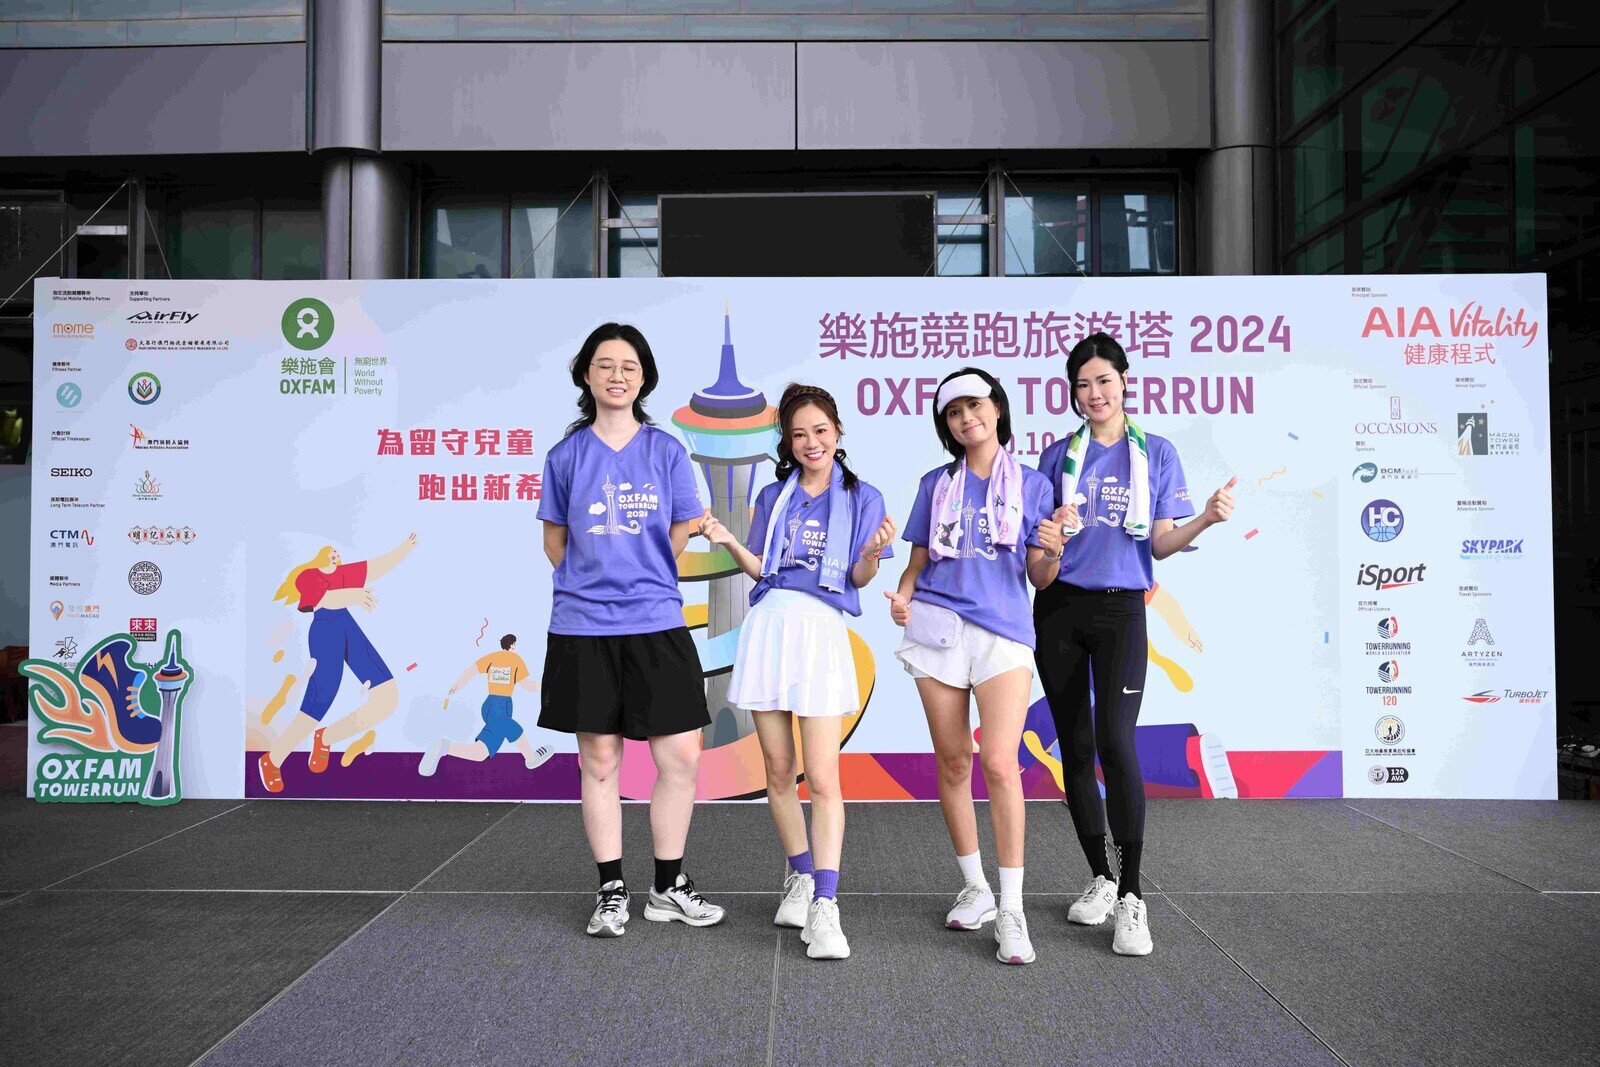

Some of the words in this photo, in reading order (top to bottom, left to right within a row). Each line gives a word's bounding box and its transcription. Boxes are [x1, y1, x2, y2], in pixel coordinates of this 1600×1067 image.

[126, 310, 200, 324] AirFly
[52, 323, 94, 334] mome
[1361, 306, 1442, 338] AIA
[1449, 301, 1539, 349] Vitality
[1189, 314, 1292, 354] 2024
[1403, 342, 1497, 366] 健康程式
[280, 356, 336, 376] 樂施會
[354, 356, 388, 366] 無窮世界
[354, 369, 375, 377] World
[280, 378, 336, 395] OXFAM
[354, 378, 384, 386] Without
[354, 387, 383, 396] Poverty
[1017, 376, 1254, 415] TOERRUN
[1354, 422, 1438, 435] OCCASIONS
[376, 428, 534, 456] 為留守兒童
[50, 467, 93, 477] SEIKO
[418, 473, 543, 501] 跑出新希
[618, 493, 659, 504] OXFAM
[618, 502, 658, 511] TOWERRUN
[1107, 503, 1128, 511] 202
[1368, 506, 1401, 528] HC
[50, 529, 79, 539] CTM
[803, 530, 827, 541] OXF
[808, 548, 825, 557] 202
[1461, 539, 1524, 554] SKYPARK
[1356, 562, 1427, 590] iSport
[1365, 642, 1411, 651] TOWERRUNNING
[1366, 686, 1412, 694] TOWERRUNNING
[1382, 696, 1397, 706] 120
[41, 757, 142, 780] OXFAM
[38, 782, 141, 797] TOWERRUN
